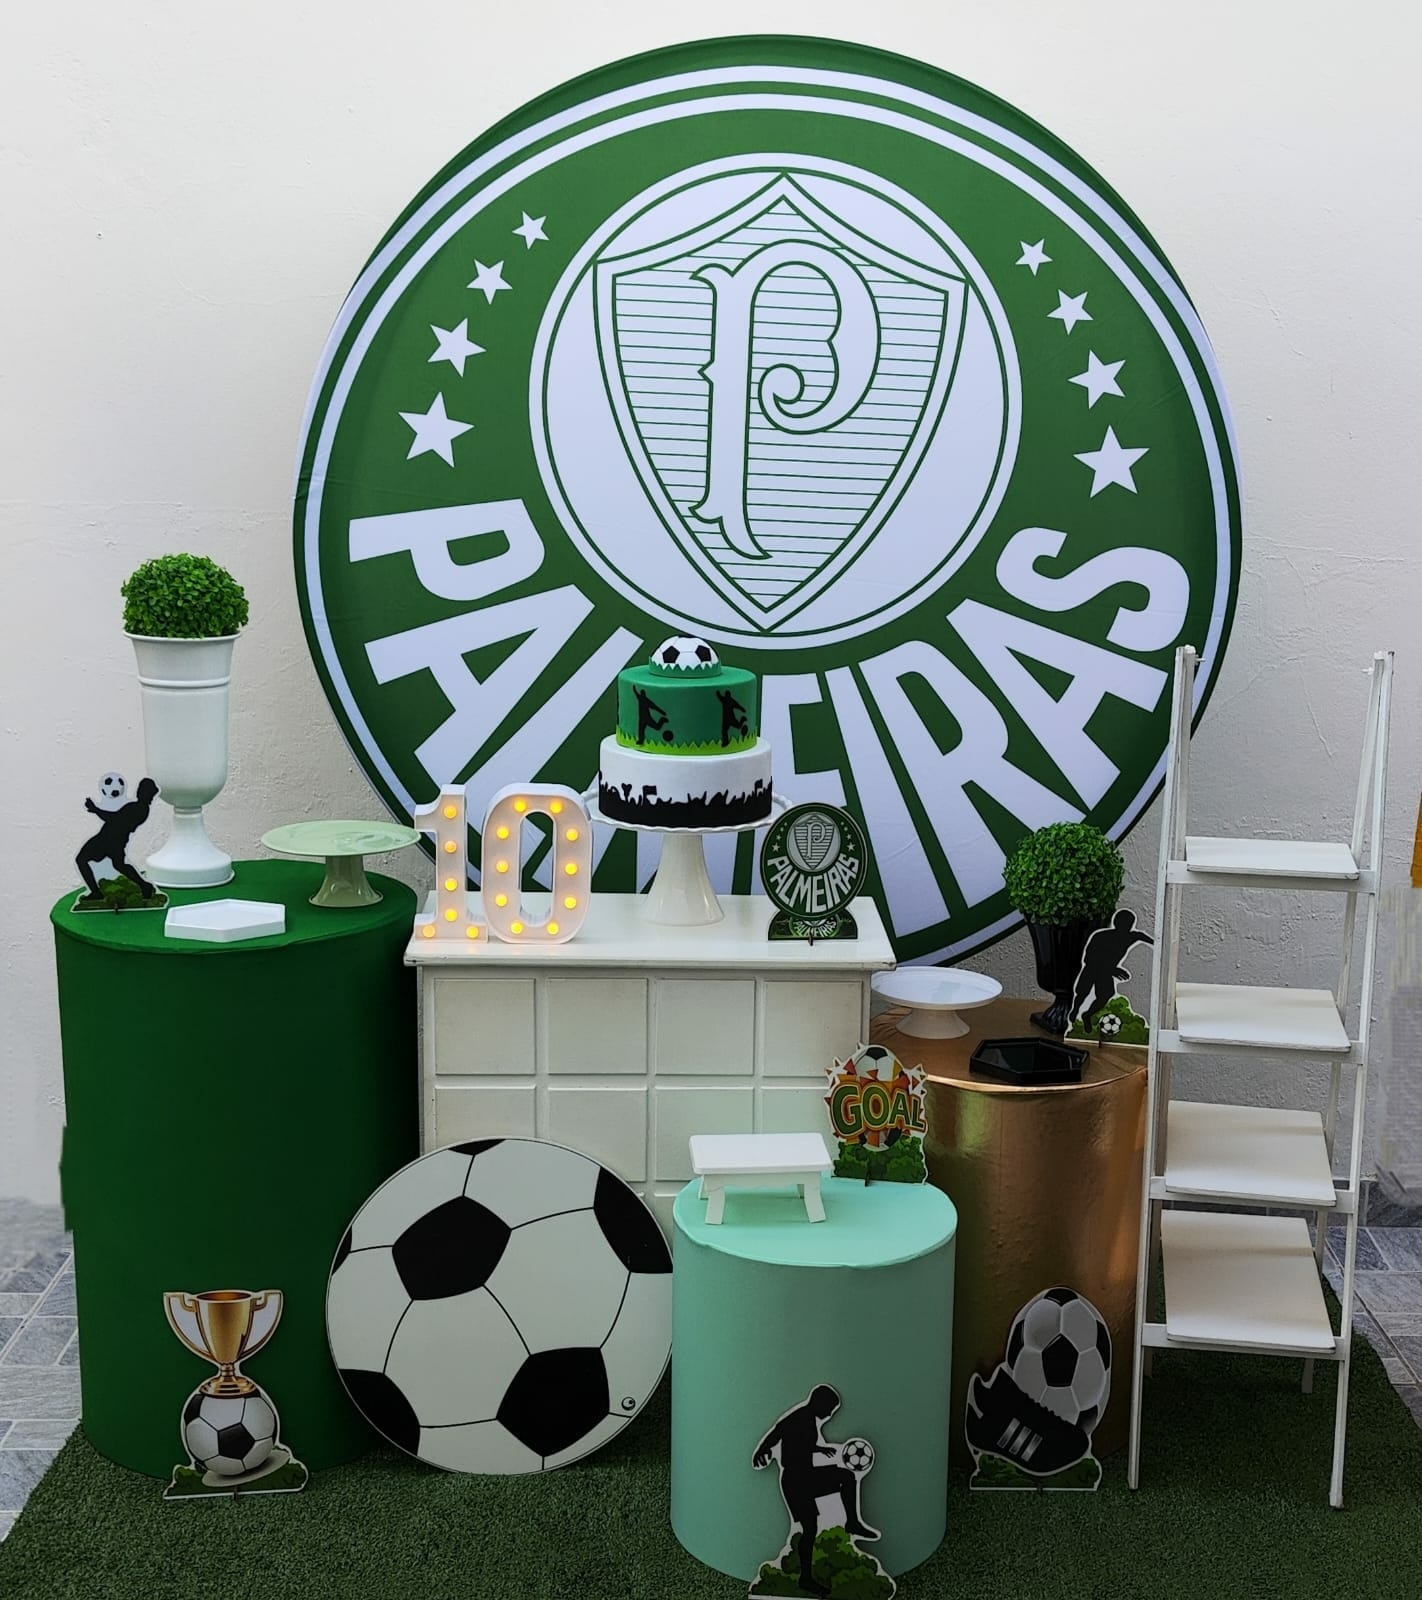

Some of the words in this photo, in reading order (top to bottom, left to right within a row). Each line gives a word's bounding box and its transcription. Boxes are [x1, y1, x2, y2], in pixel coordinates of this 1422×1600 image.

[414, 783, 593, 944] 10
[767, 853, 860, 913] PALMEIRAS
[831, 1083, 927, 1137] GOAL
